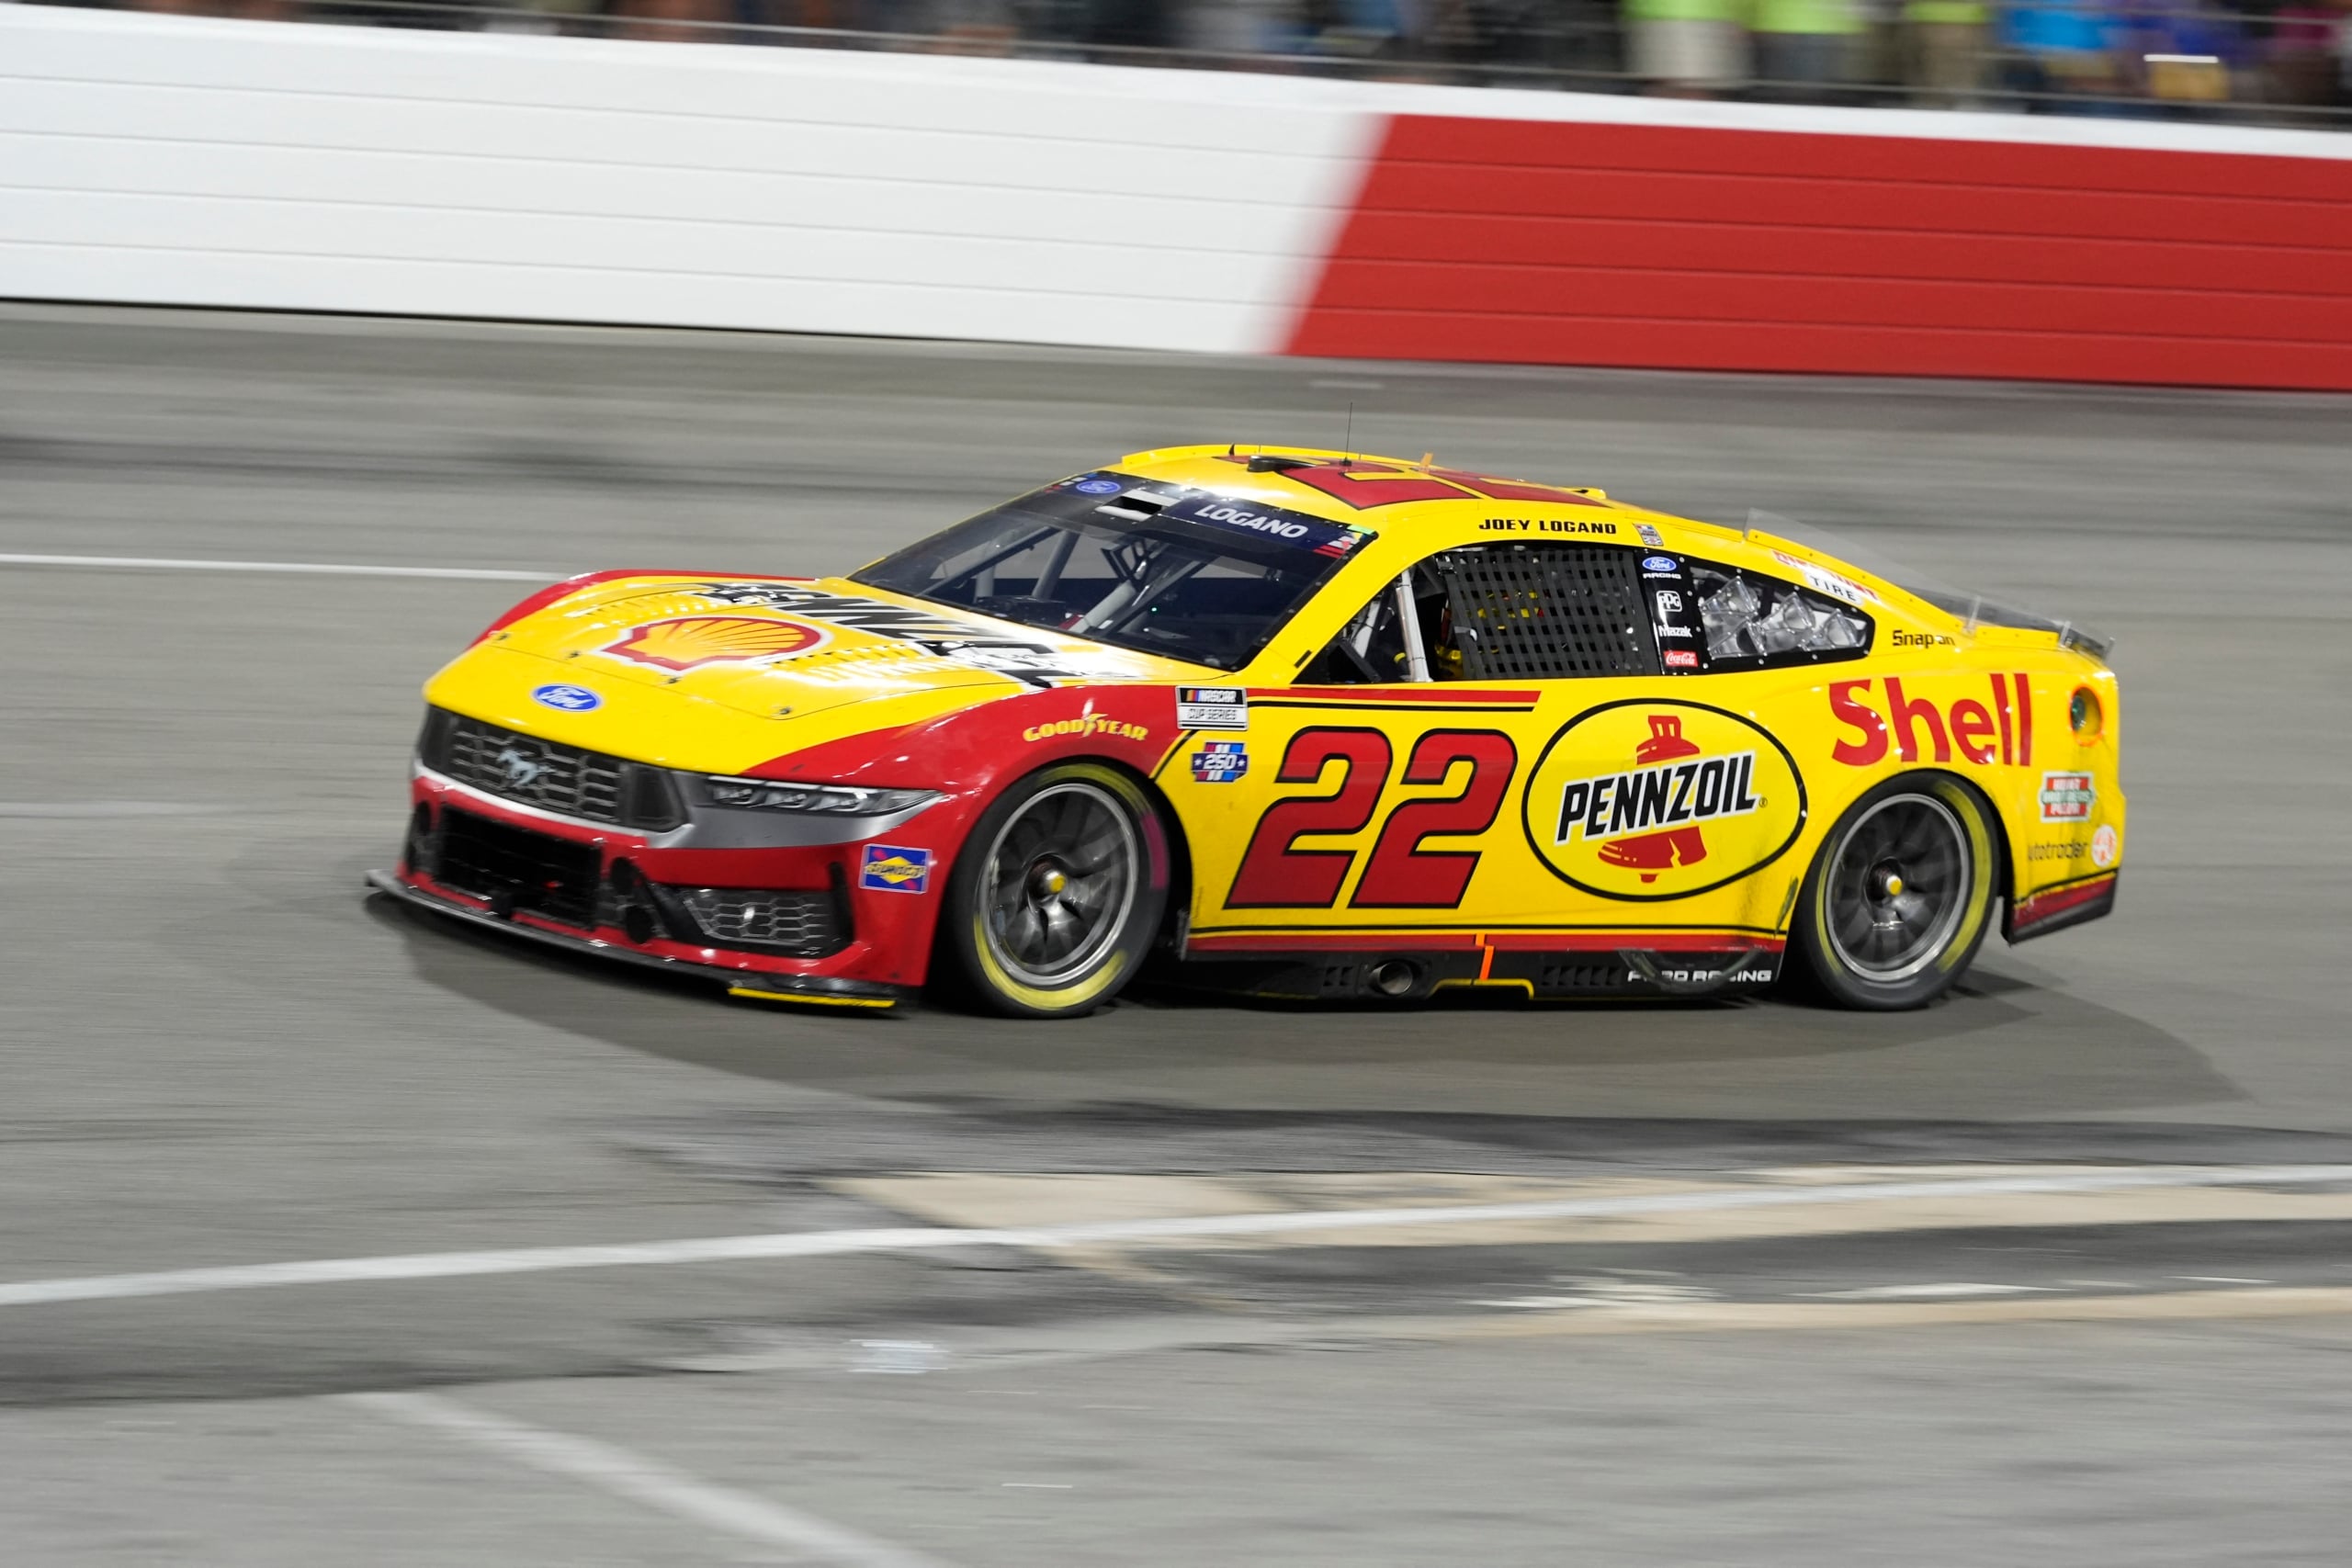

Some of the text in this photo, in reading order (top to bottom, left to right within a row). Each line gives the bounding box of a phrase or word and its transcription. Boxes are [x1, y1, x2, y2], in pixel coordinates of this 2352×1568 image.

[1194, 504, 1309, 538] LOGANO
[1478, 519, 1617, 535] JOEY LOGANO
[1648, 558, 1671, 570] Ford
[1809, 575, 1856, 602] TIRE
[1657, 625, 1693, 637] Mazak
[537, 687, 594, 708] Ford
[1207, 708, 1238, 721] SERIES
[1829, 673, 2032, 767] Shell
[1023, 713, 1148, 741] GOODYEAR
[1202, 753, 1238, 771] 250
[1555, 751, 1758, 845] PENNZOIL
[1222, 725, 1519, 910] 22
[1627, 970, 1772, 983] FRD RAING
